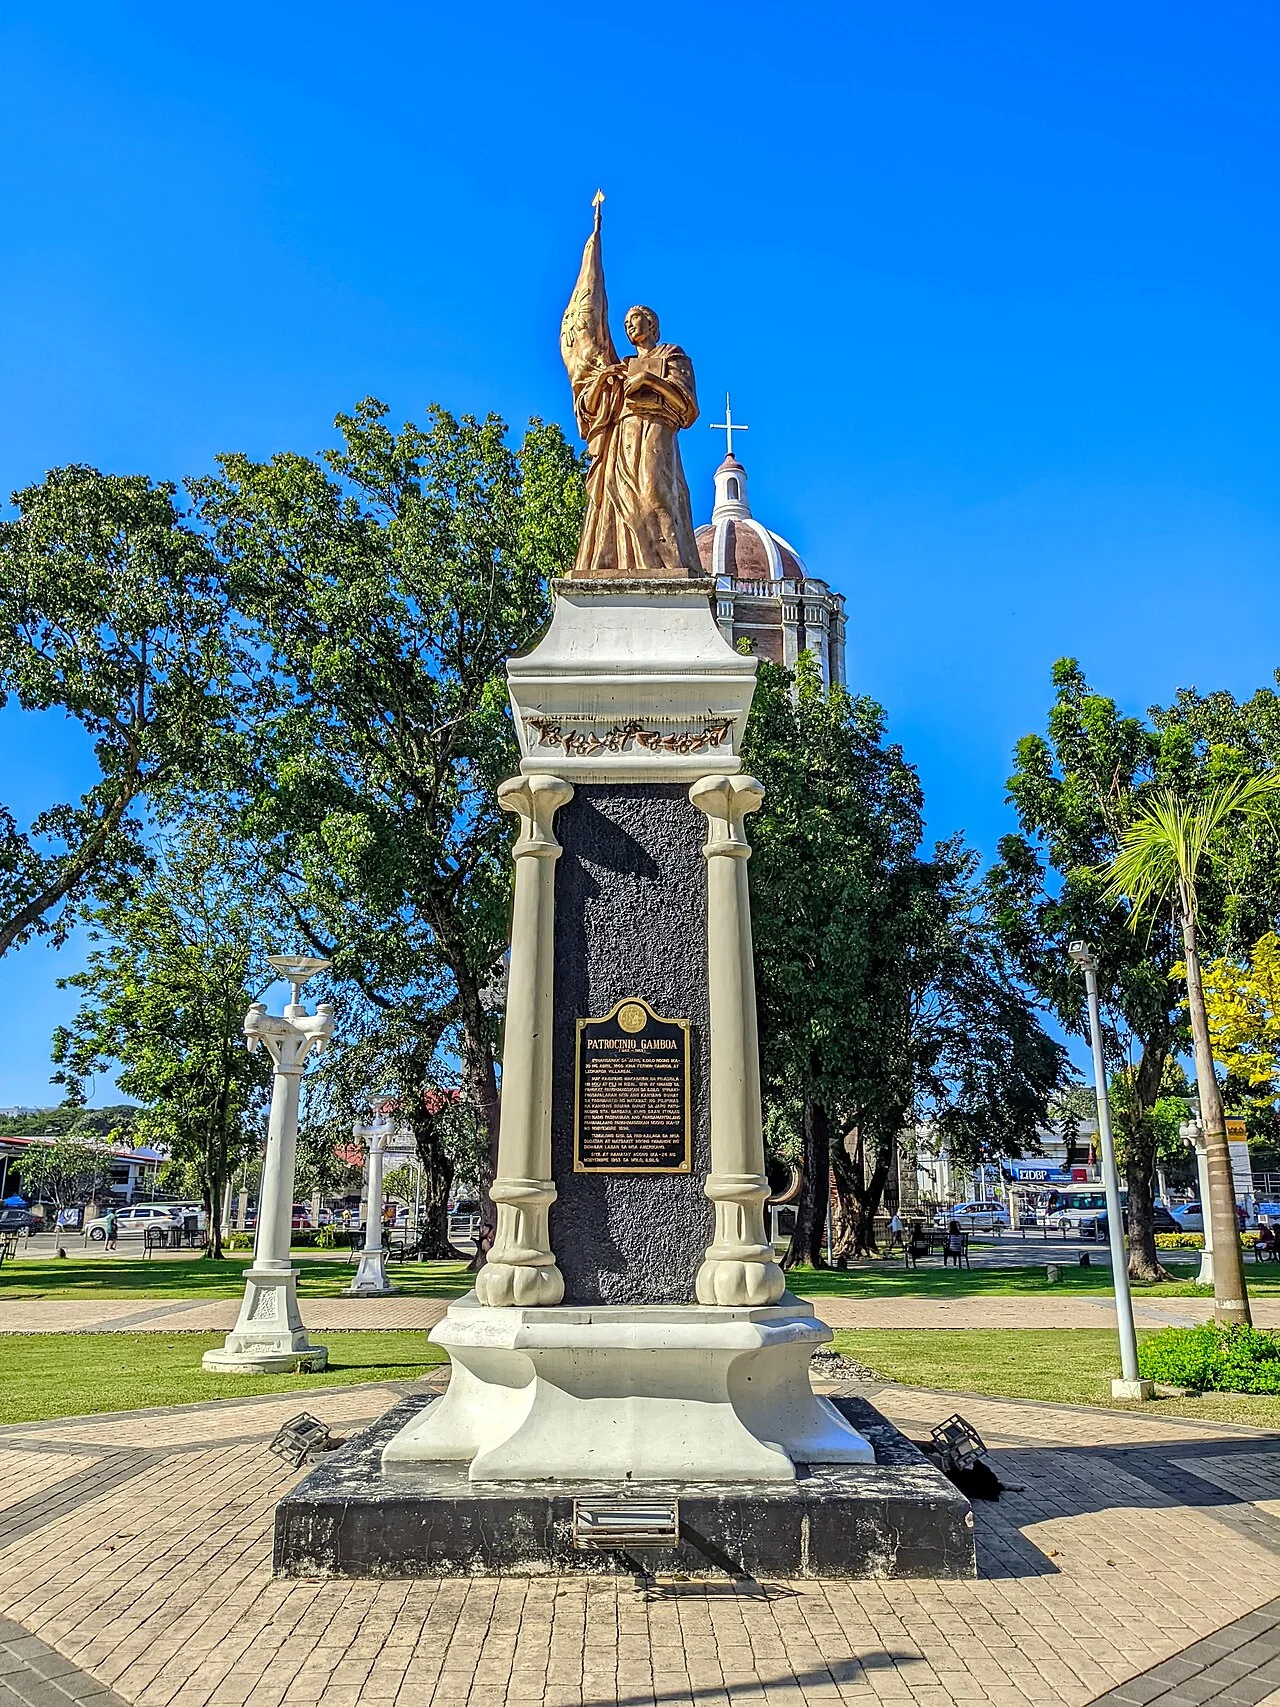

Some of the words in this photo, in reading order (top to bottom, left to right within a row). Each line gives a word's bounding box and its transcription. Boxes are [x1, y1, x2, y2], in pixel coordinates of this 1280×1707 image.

[587, 1039, 636, 1050] PATROCINIO
[641, 1039, 678, 1050] GAMBOA
[1029, 1170, 1047, 1180] DBP
